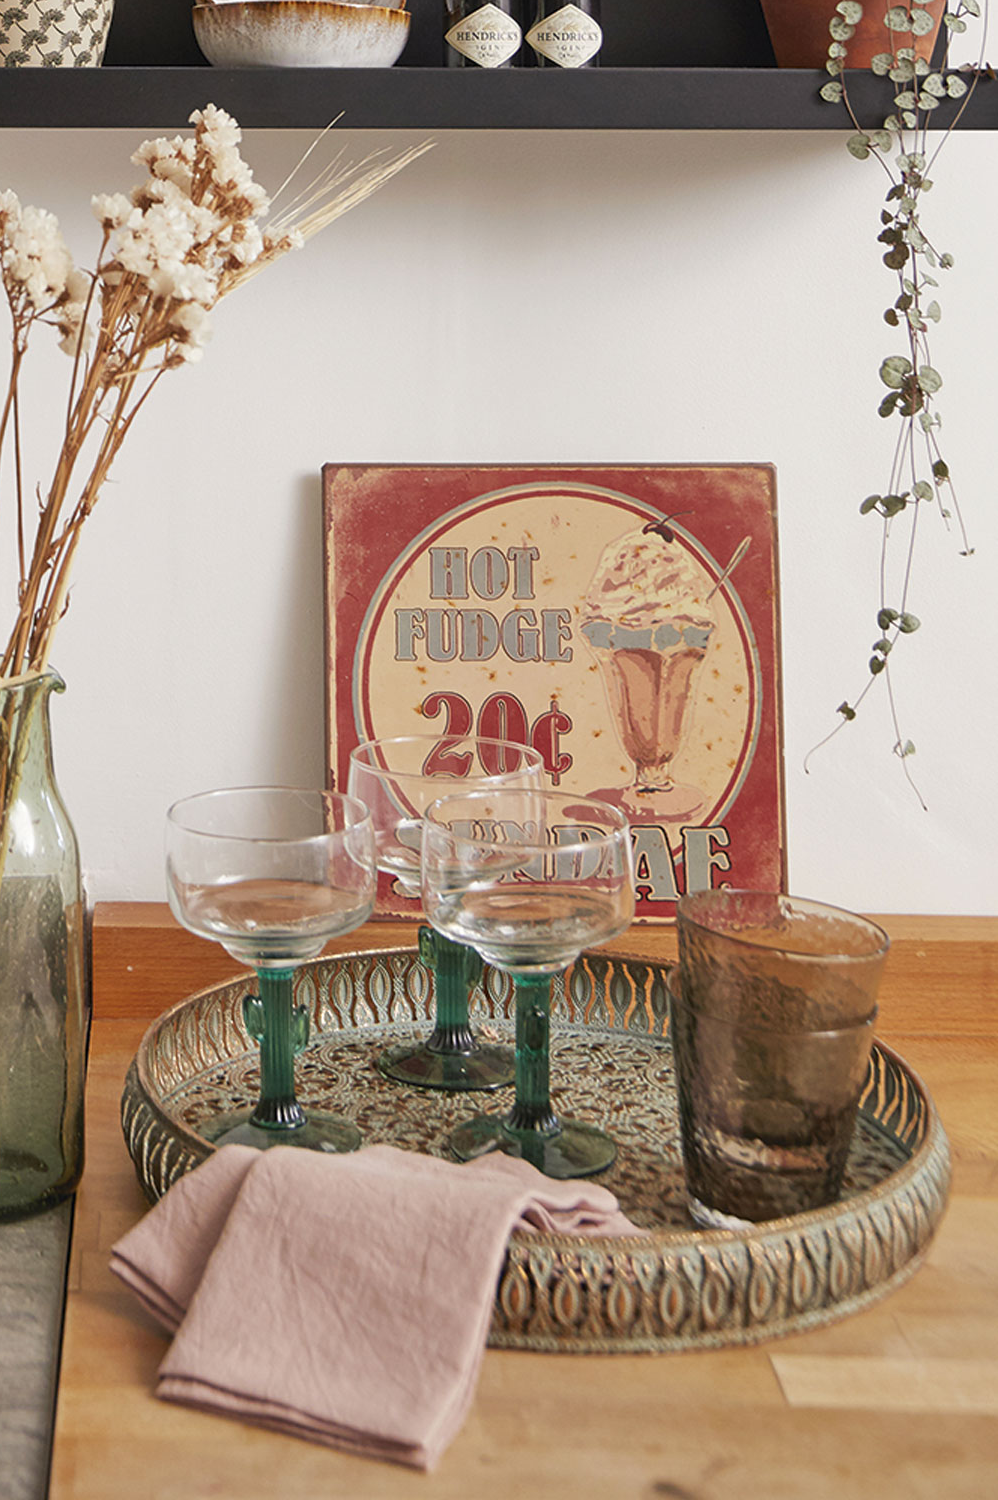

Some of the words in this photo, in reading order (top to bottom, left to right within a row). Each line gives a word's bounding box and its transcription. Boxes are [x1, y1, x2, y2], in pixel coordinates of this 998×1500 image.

[429, 546, 540, 600] HOT
[394, 608, 573, 663] FUDGE
[421, 691, 573, 787] 20¢
